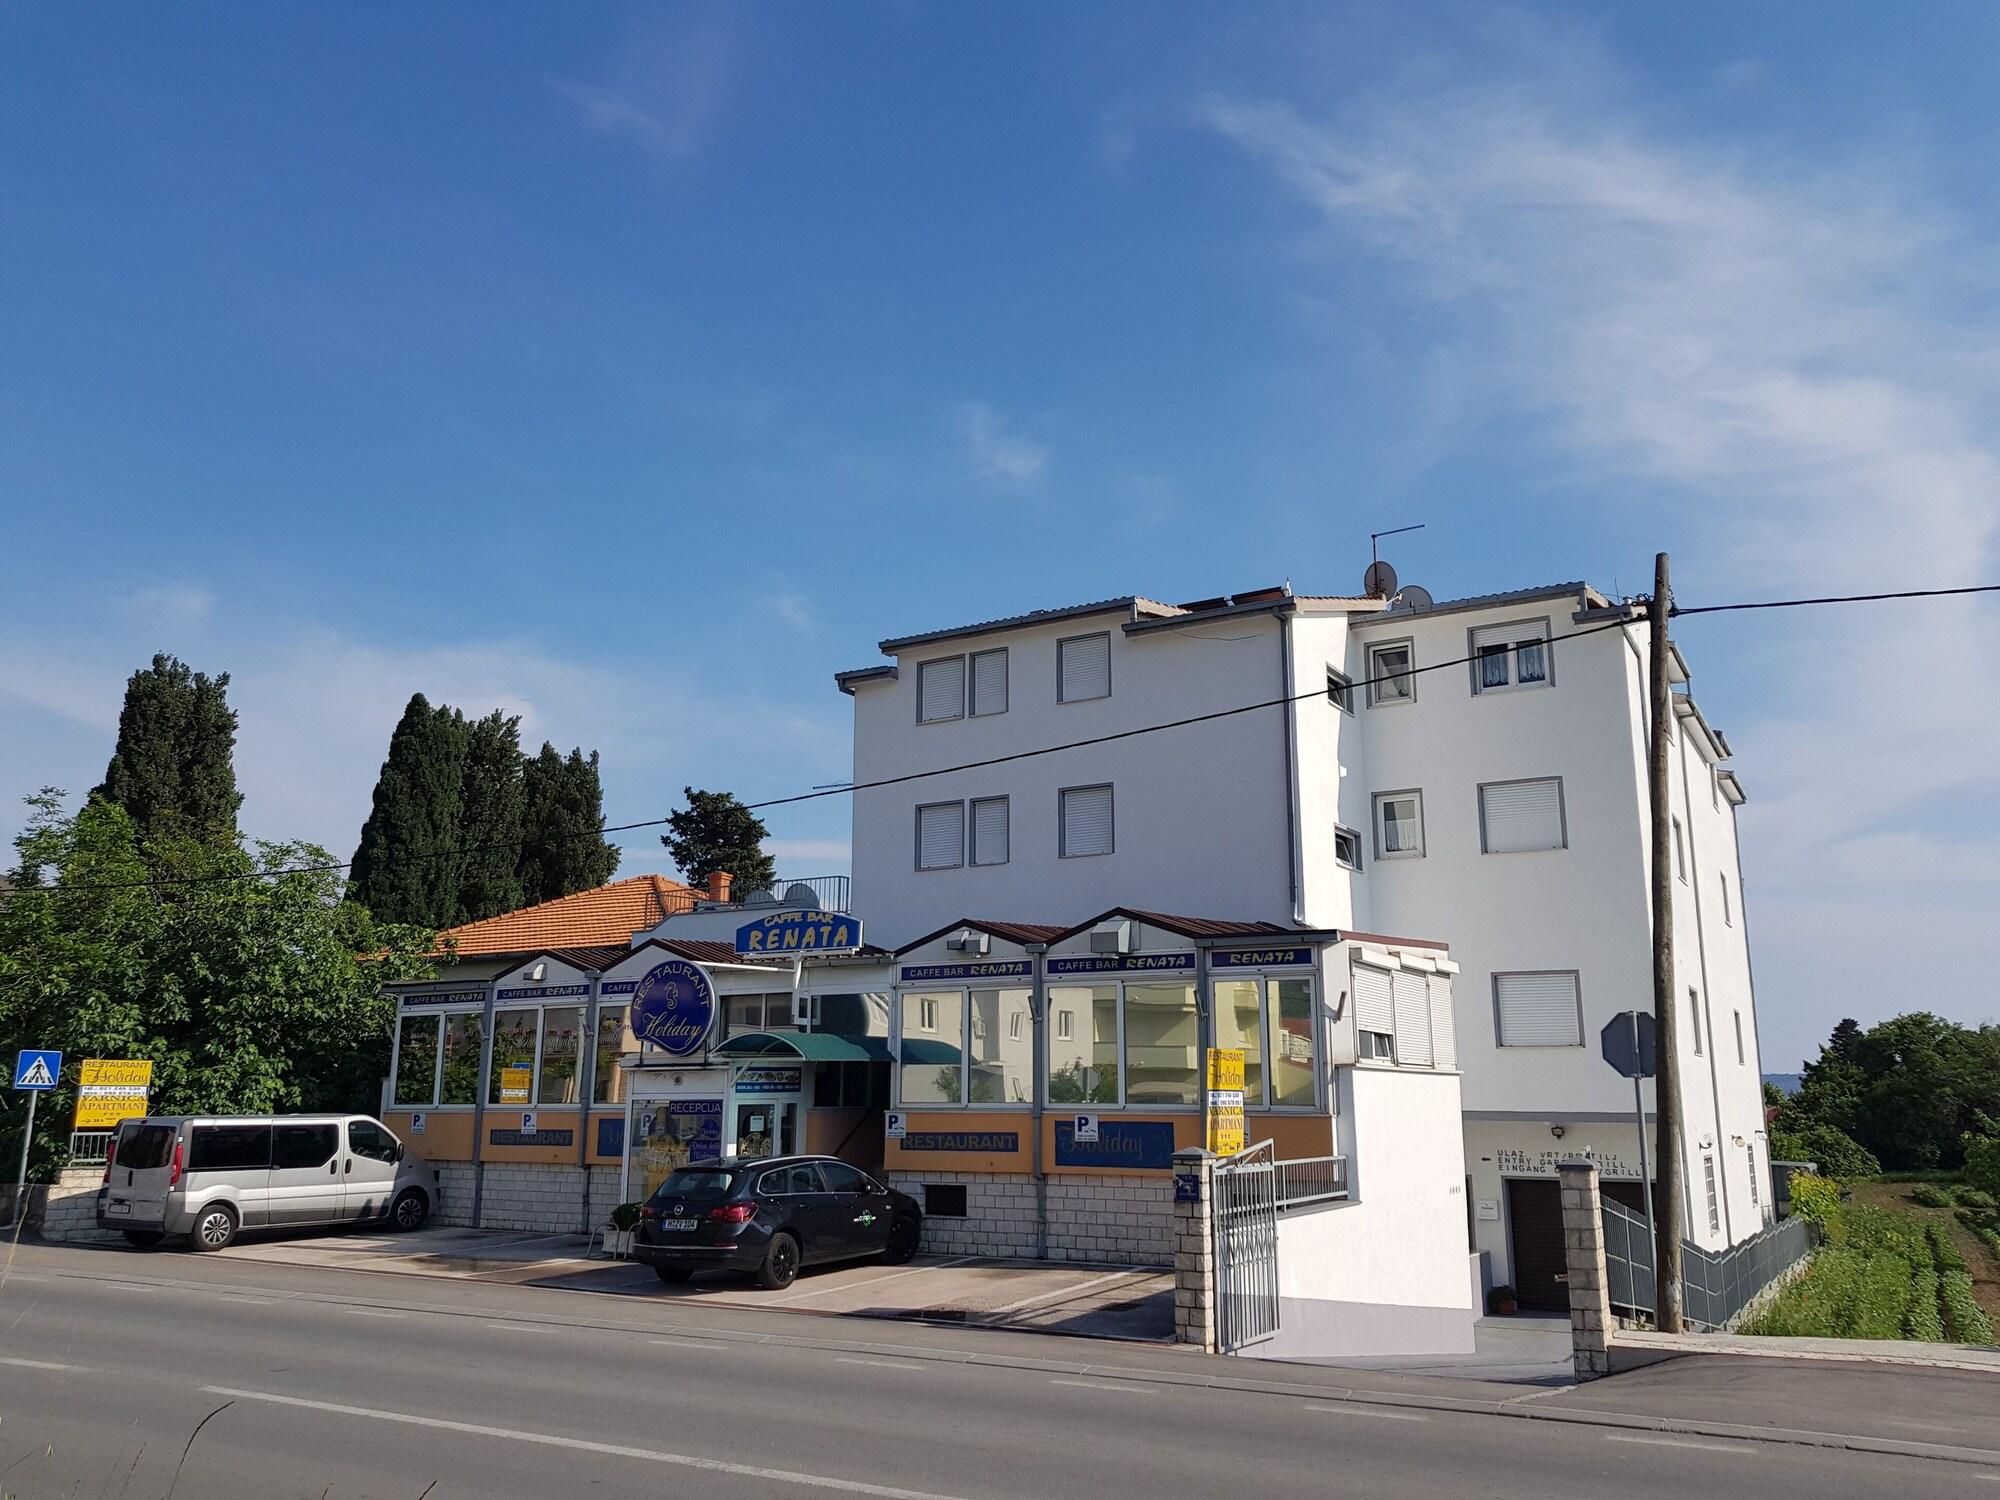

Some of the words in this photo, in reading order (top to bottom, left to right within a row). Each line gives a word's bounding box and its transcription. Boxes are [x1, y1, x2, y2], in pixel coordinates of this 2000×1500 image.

[764, 912, 803, 927] CAFFE
[807, 911, 834, 924] BAR
[748, 925, 848, 951] RENATA
[1057, 960, 1092, 970] CAFFE
[1096, 959, 1119, 969] BAR
[1126, 956, 1186, 969] RENATA
[1229, 951, 1296, 964] RENATA
[909, 969, 941, 978] CAFFE
[943, 967, 964, 976] BAR
[969, 963, 1024, 976] RENATA
[502, 989, 526, 998] CAFFE
[526, 989, 542, 997] BAR
[547, 985, 584, 996] RENATA
[607, 984, 632, 992] CAFFE
[633, 963, 710, 1010] RESTAURANT
[410, 996, 431, 1004] CAFFE
[431, 995, 446, 1003] BAR
[449, 992, 484, 1002] RENATA
[640, 1011, 702, 1047] Holiday
[1209, 1049, 1244, 1062] RESTAURANT
[84, 1061, 149, 1069] RESTAURANT
[84, 1069, 148, 1084] Holiday
[1208, 1063, 1244, 1090] Holiday
[80, 1103, 144, 1111] APARTMANI
[670, 1102, 722, 1113] RECEPCIJA
[1208, 1106, 1244, 1116] VARNICA
[1209, 1118, 1244, 1131] APARTMANI
[493, 1131, 570, 1145] RESTAURANT
[904, 1133, 1016, 1150] RESTAURANT
[1497, 1150, 1525, 1158] ULAZ
[1497, 1157, 1532, 1165] ENTRY
[1498, 1164, 1547, 1173] EINGANG
